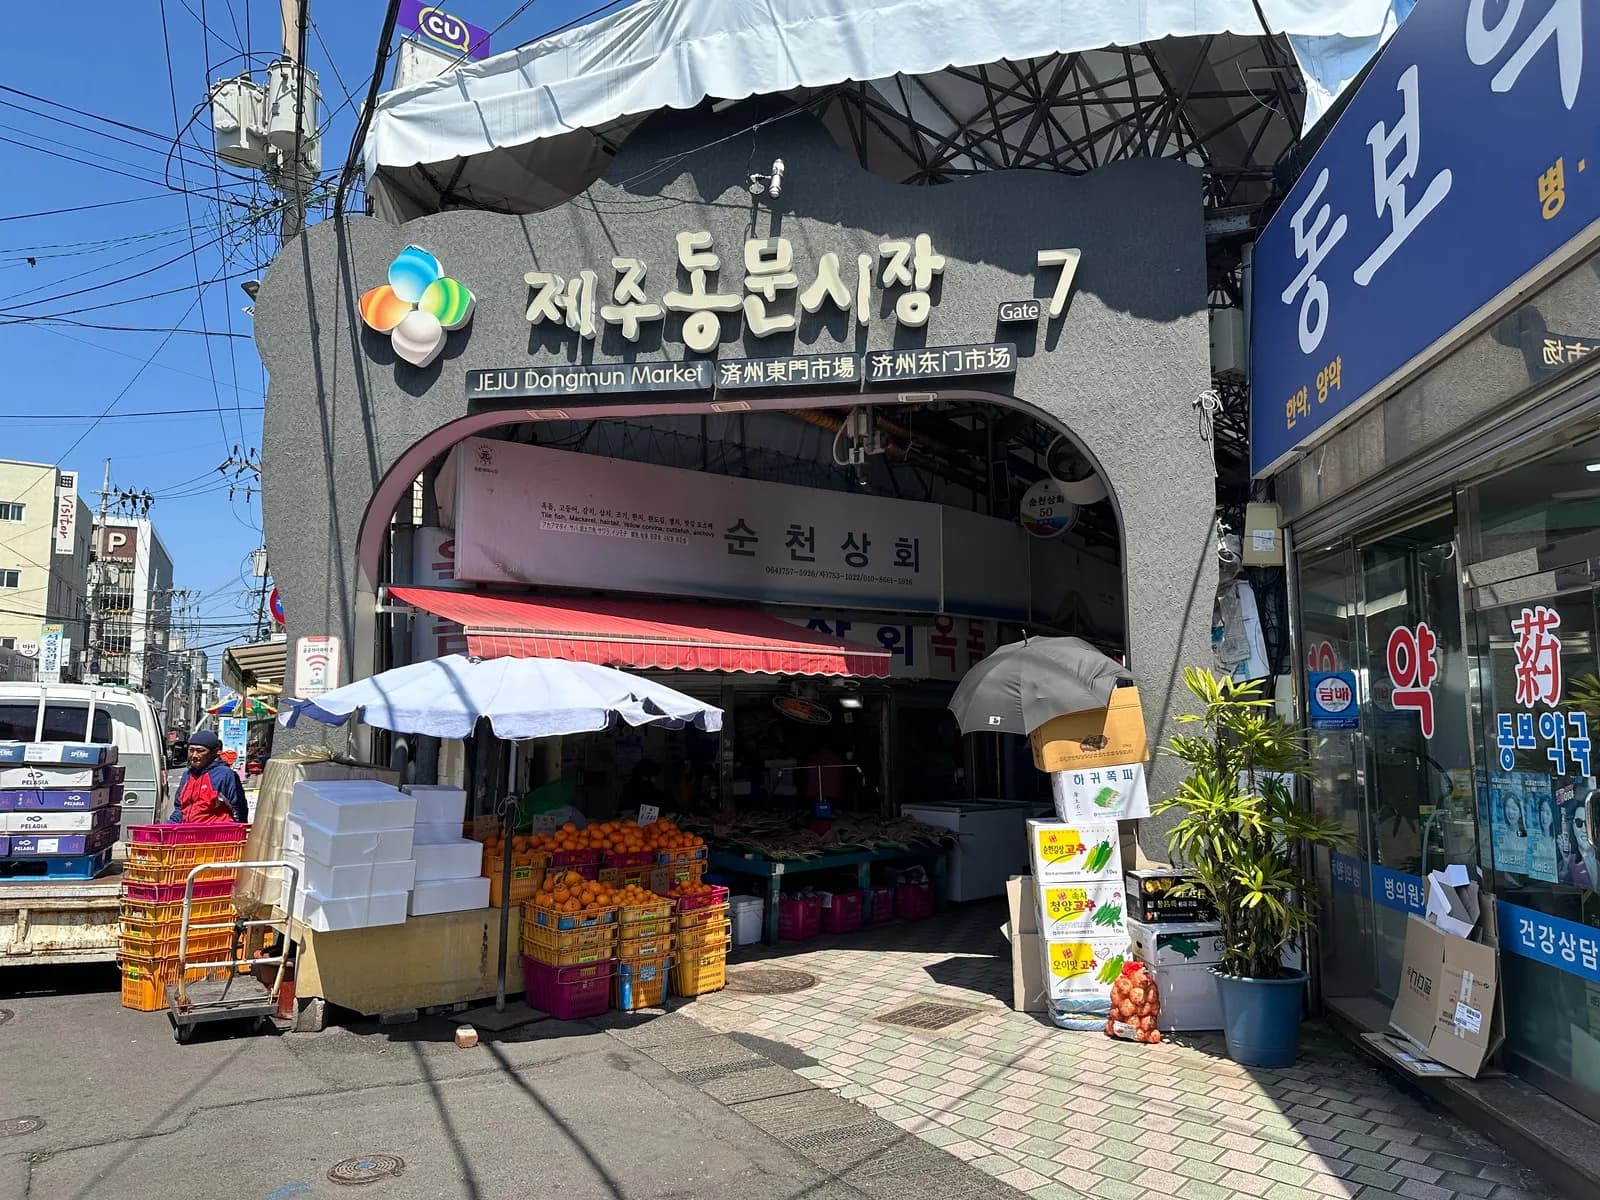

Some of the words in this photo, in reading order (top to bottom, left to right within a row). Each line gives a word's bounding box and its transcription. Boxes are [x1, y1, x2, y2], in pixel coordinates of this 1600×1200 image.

[428, 16, 460, 40] CU
[524, 231, 945, 353] 제주동문시장
[1001, 302, 1038, 321] Gate
[1037, 248, 1081, 317] 7
[474, 369, 518, 393] JEJU
[524, 365, 625, 392] Dongmun
[630, 363, 704, 387] Market
[872, 347, 1010, 379] 济州东门市场
[1316, 355, 1342, 404] 양약
[60, 494, 74, 538] Visitor
[1040, 507, 1053, 517] 50
[108, 532, 126, 553] P
[1319, 687, 1349, 702] 담배
[1386, 622, 1438, 740] 약
[1496, 711, 1591, 778] 동보약국
[1519, 918, 1598, 971] 건강상담
[1053, 959, 1078, 971] 오이맛
[1080, 959, 1097, 970] 고추
